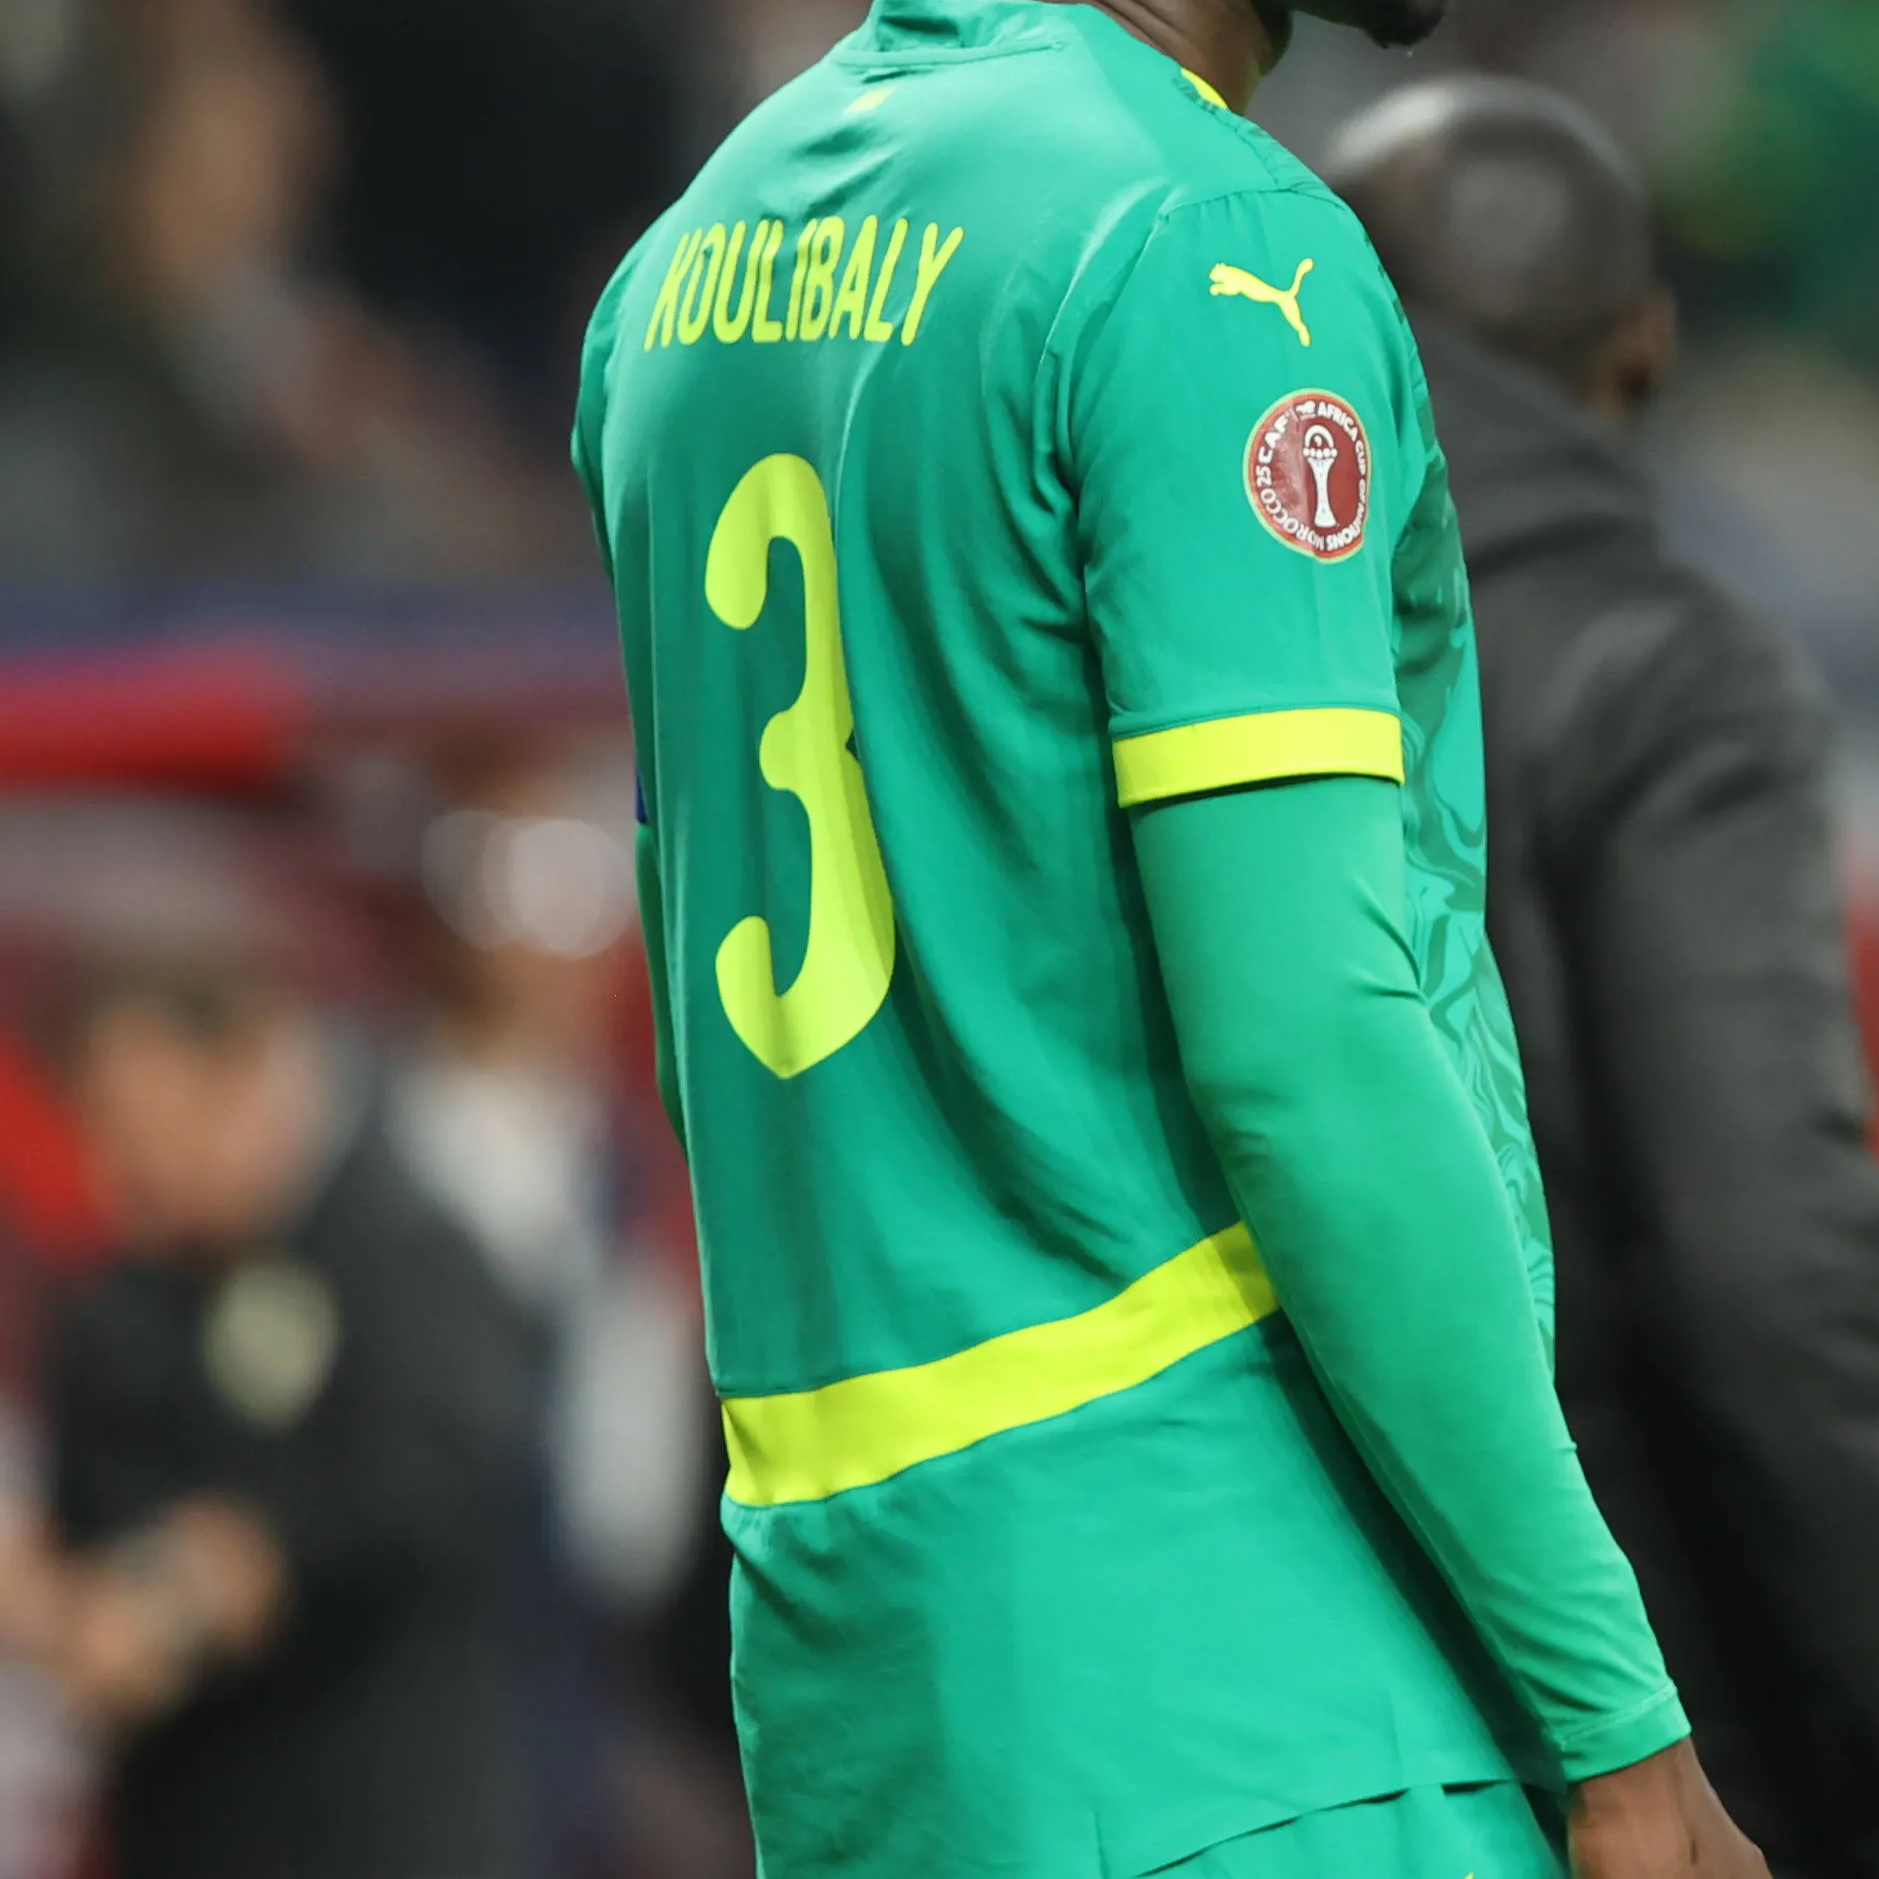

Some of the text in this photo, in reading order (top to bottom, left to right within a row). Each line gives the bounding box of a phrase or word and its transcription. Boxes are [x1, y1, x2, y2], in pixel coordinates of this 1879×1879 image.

[644, 214, 963, 353] KOULIBALY
[1258, 412, 1289, 464] CAF
[1317, 401, 1359, 443] AFRICA
[1256, 465, 1273, 488] 25
[704, 452, 896, 1079] 3
